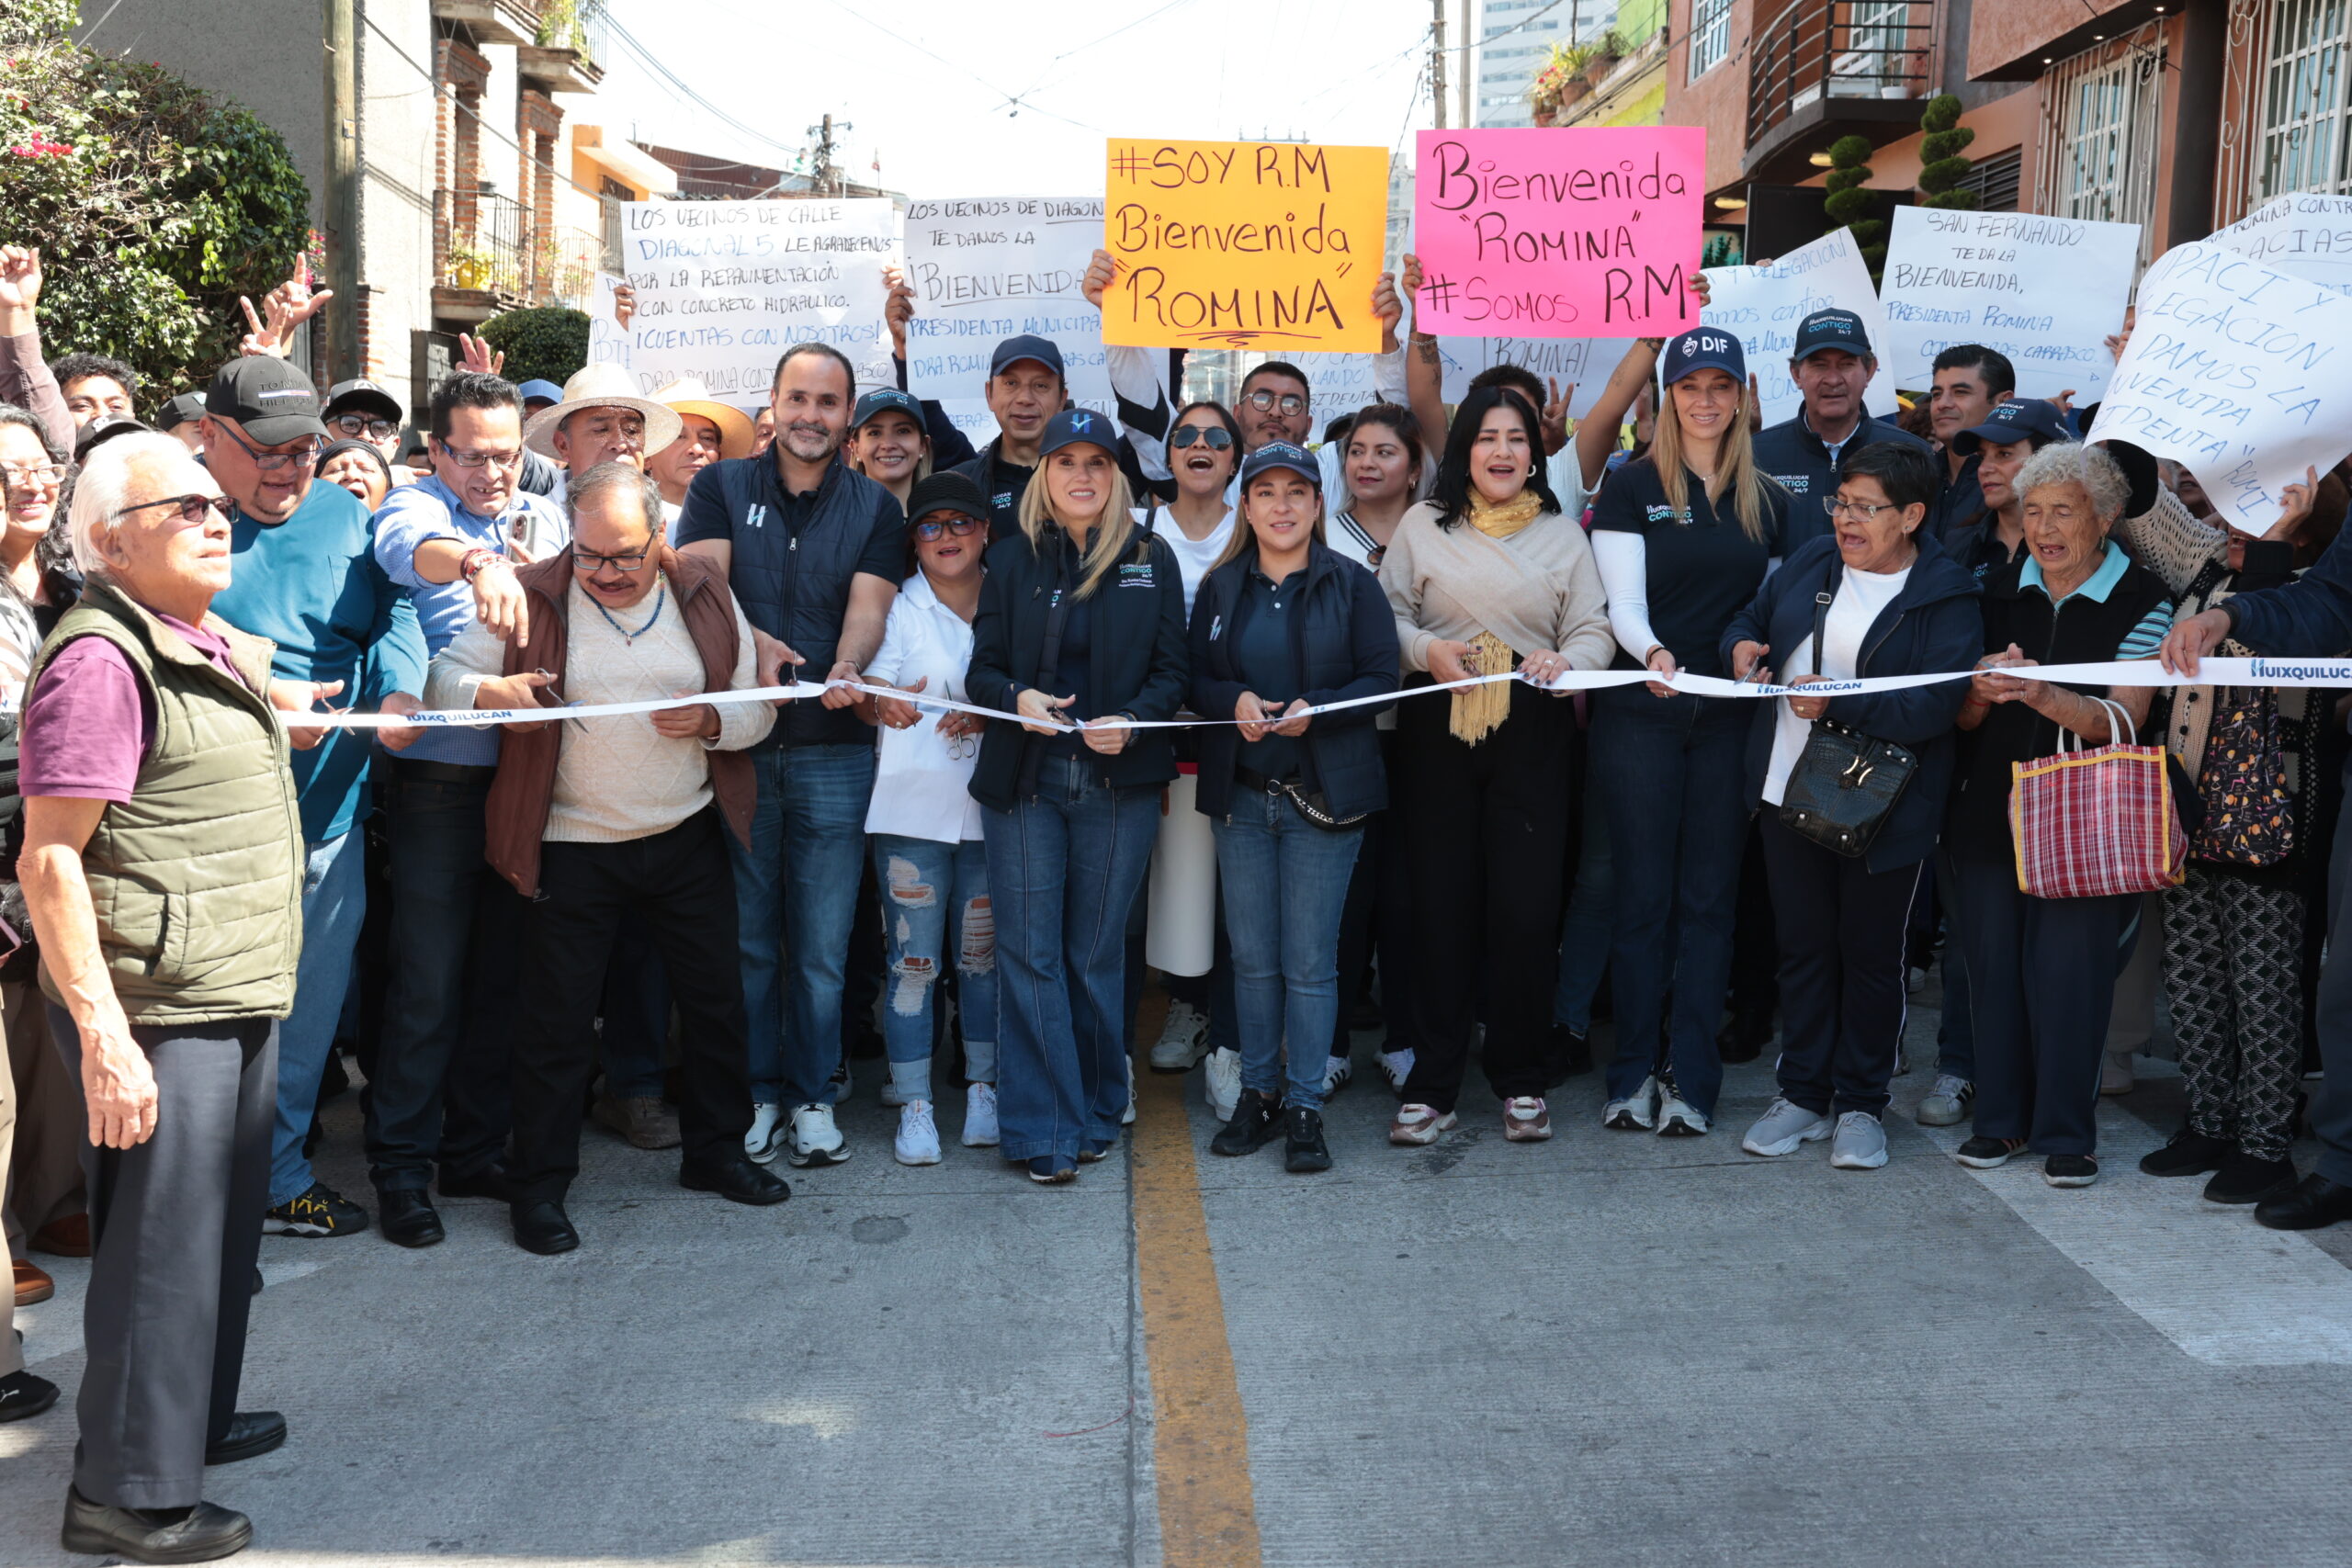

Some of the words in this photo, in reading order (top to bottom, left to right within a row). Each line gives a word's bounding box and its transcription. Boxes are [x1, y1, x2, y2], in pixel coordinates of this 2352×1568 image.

[1111, 146, 1235, 188] #SOY
[1430, 141, 1686, 210] Bienvenida
[908, 203, 938, 220] LOS
[1018, 200, 1038, 215] DE
[1044, 202, 1104, 218] DIAGON
[2297, 197, 2352, 214] CONTR
[631, 209, 665, 231] LOS
[757, 207, 780, 224] DE
[788, 206, 842, 223] CALLE
[1114, 202, 1351, 254] Bienvenida
[1928, 211, 1968, 234] SAN
[1976, 215, 2086, 247] FERNANDO
[639, 233, 750, 261] DIAGONAL
[756, 233, 774, 256] 5
[786, 236, 810, 254] LE
[928, 230, 950, 247] TE
[957, 231, 1008, 247] DAMOS
[1014, 231, 1036, 245] LA
[1459, 209, 1641, 264] "ROMINA"
[2248, 228, 2352, 260] ACIAS
[1951, 247, 1974, 260] TE
[1978, 248, 1996, 262] DA
[1998, 250, 2017, 263] LA
[628, 274, 659, 290] POR
[670, 270, 688, 288] LA
[1114, 258, 1353, 330] "ROMINA"
[2295, 292, 2336, 313] Y
[639, 300, 673, 317] CON
[681, 297, 756, 314] CONCRETO
[1702, 307, 1760, 325] amos
[1886, 301, 1971, 324] PRESIDENTA
[1983, 305, 2053, 332] ROMINA
[741, 328, 777, 345] CON
[785, 320, 880, 345] NOSOTROS!
[910, 317, 1013, 337] PRESIDENTA
[1023, 314, 1102, 336] MUNICIPA
[1808, 321, 1851, 333] CONTIGO
[2138, 291, 2334, 370] LEGACION
[1702, 335, 1728, 355] DIF
[913, 357, 945, 378] DRA.
[947, 353, 991, 374] ROMI
[2136, 333, 2261, 389] DAMOS
[2267, 385, 2321, 425] LA
[1309, 389, 1375, 406] SIDENTA
[2111, 372, 2252, 426] NVENIDA
[2091, 404, 2230, 464] IDENTA
[1779, 479, 1808, 488] NTIGO
[1648, 510, 1691, 522] CONTIGO
[2250, 659, 2352, 681] HUIXQUILUC
